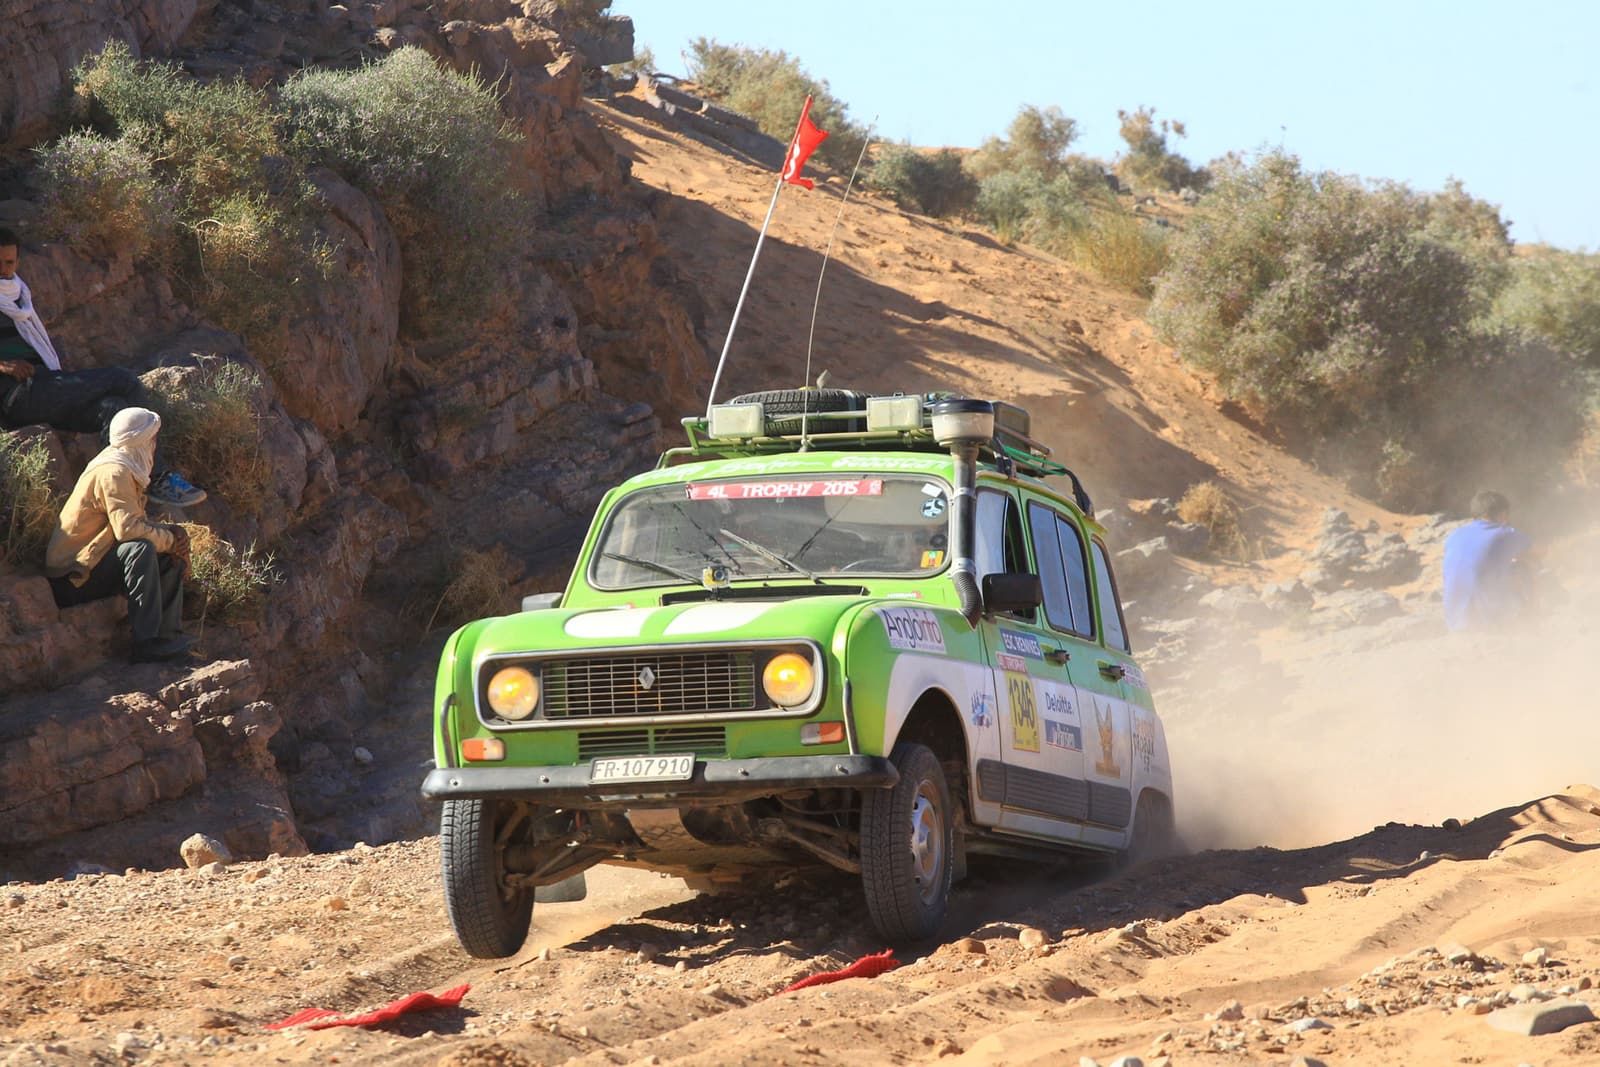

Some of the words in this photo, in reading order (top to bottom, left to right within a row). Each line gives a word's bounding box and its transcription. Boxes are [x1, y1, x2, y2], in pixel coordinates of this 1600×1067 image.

[707, 486, 729, 498] 4L
[742, 483, 813, 497] TROPHY
[822, 480, 859, 496] 2015
